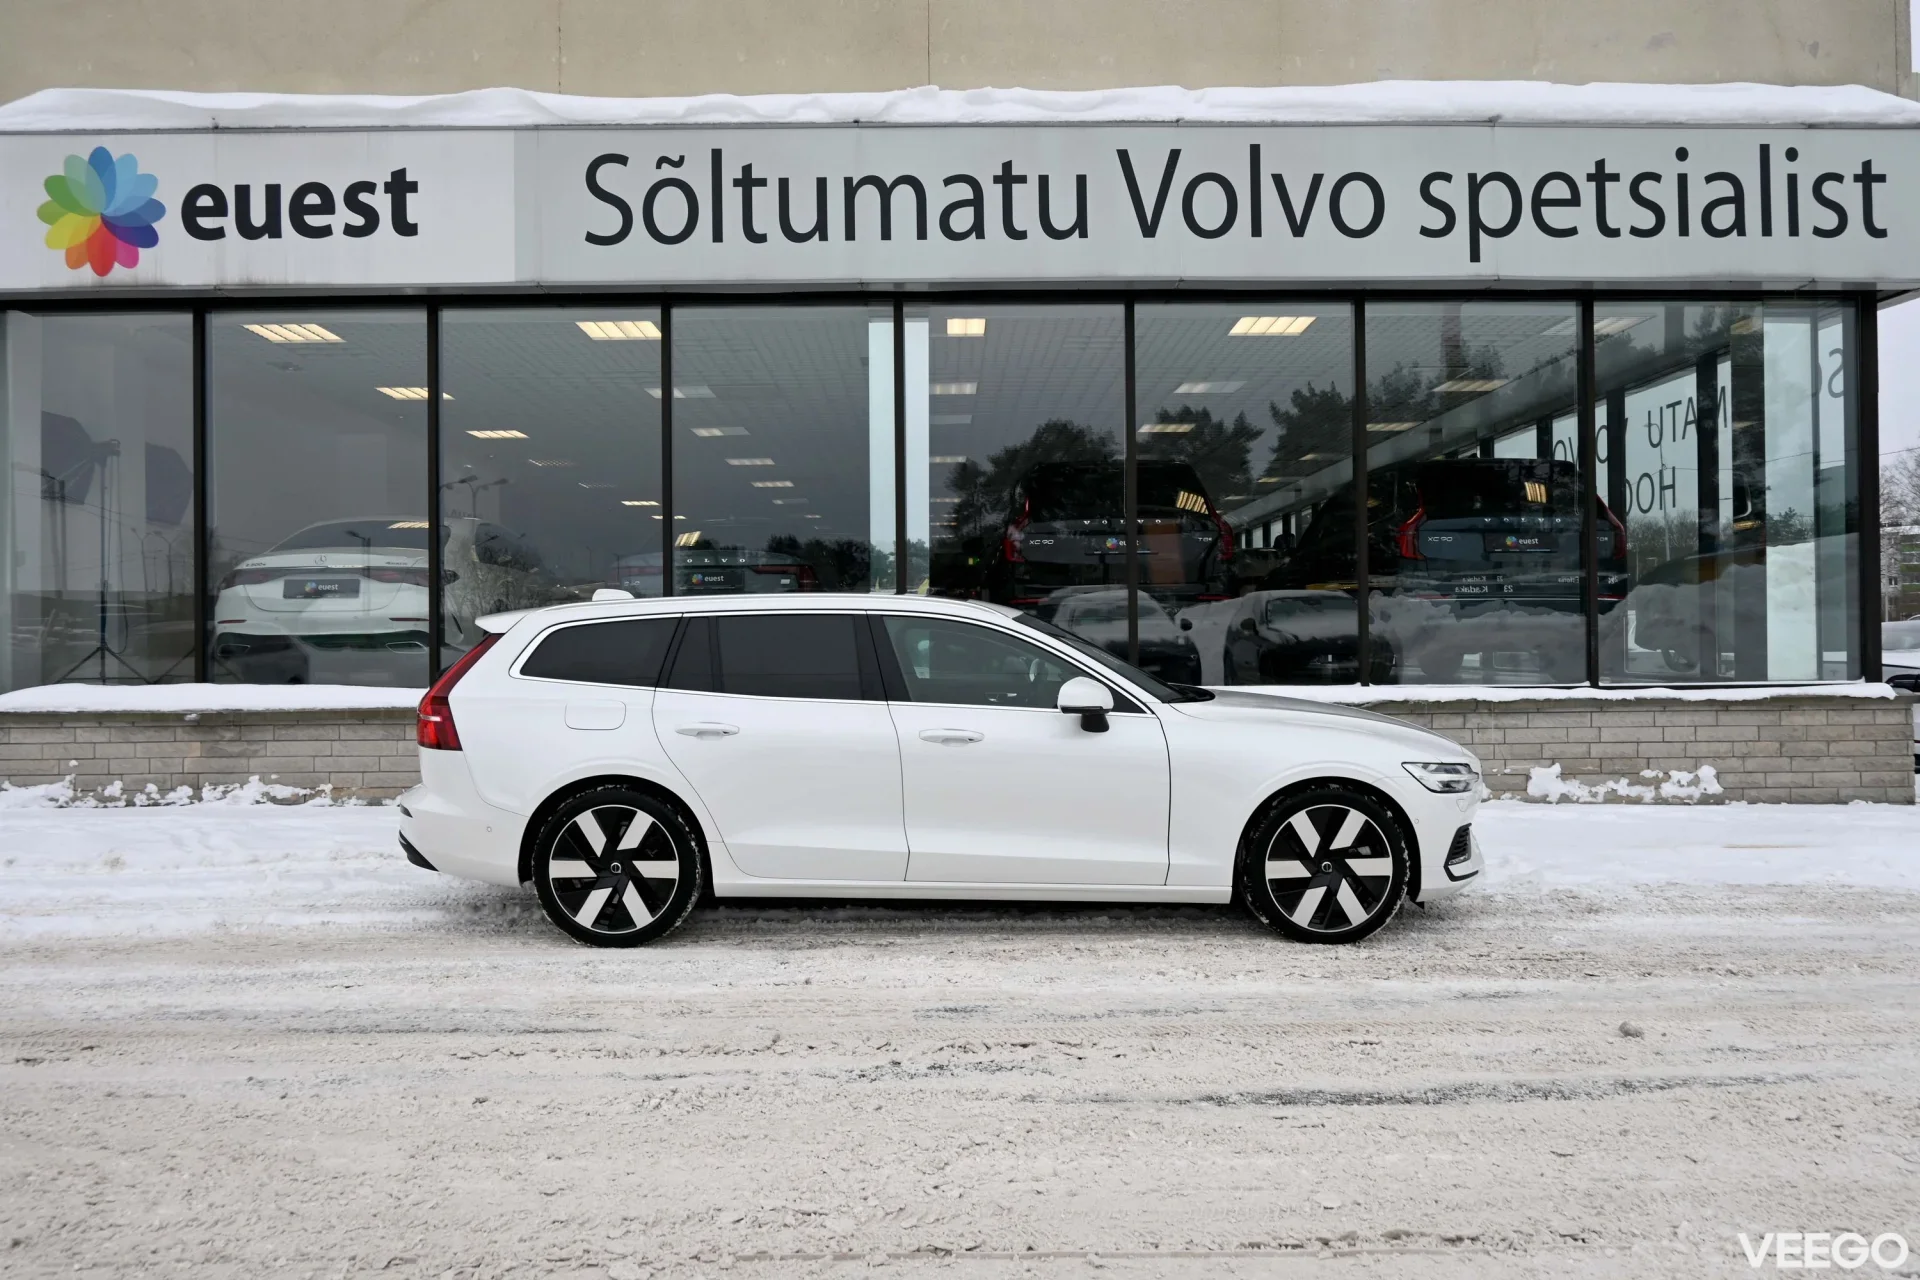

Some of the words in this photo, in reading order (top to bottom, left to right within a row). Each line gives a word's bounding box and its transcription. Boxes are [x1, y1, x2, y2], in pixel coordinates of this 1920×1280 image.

[181, 166, 419, 242] euest
[584, 148, 1090, 247] Sõltumatu
[1115, 143, 1386, 240] Volvo
[1418, 143, 1889, 263] spetsialist
[1518, 537, 1539, 545] euest
[704, 574, 725, 582] euest
[318, 583, 339, 591] euest
